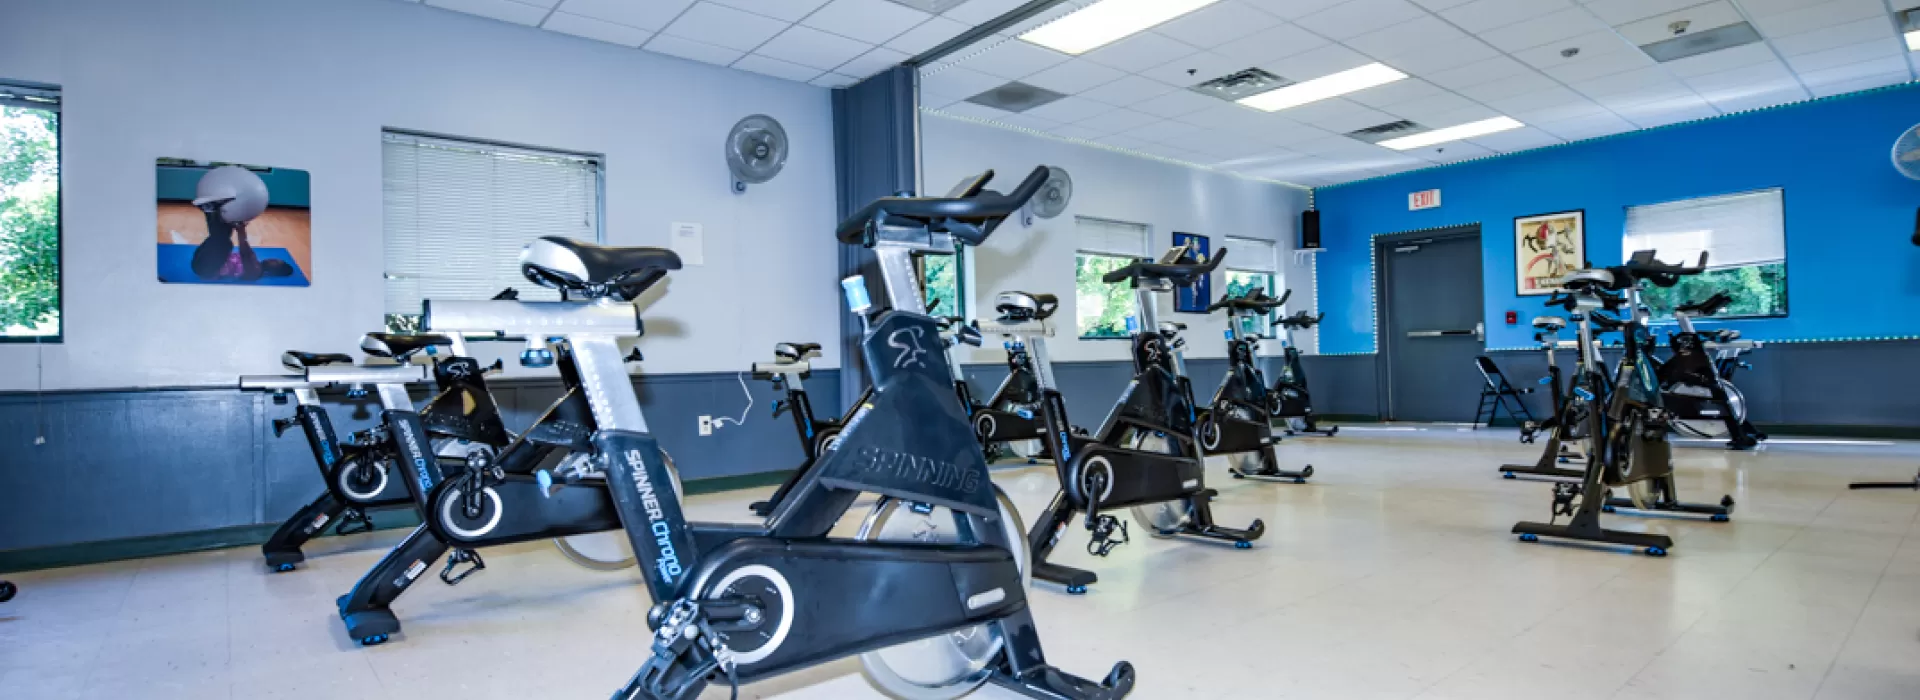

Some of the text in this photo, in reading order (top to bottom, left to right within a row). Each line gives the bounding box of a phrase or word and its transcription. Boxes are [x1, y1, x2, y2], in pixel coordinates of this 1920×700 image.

[1414, 191, 1434, 208] EXIT
[853, 446, 981, 494] SPINNING
[624, 449, 682, 576] SPINNER Chrono
